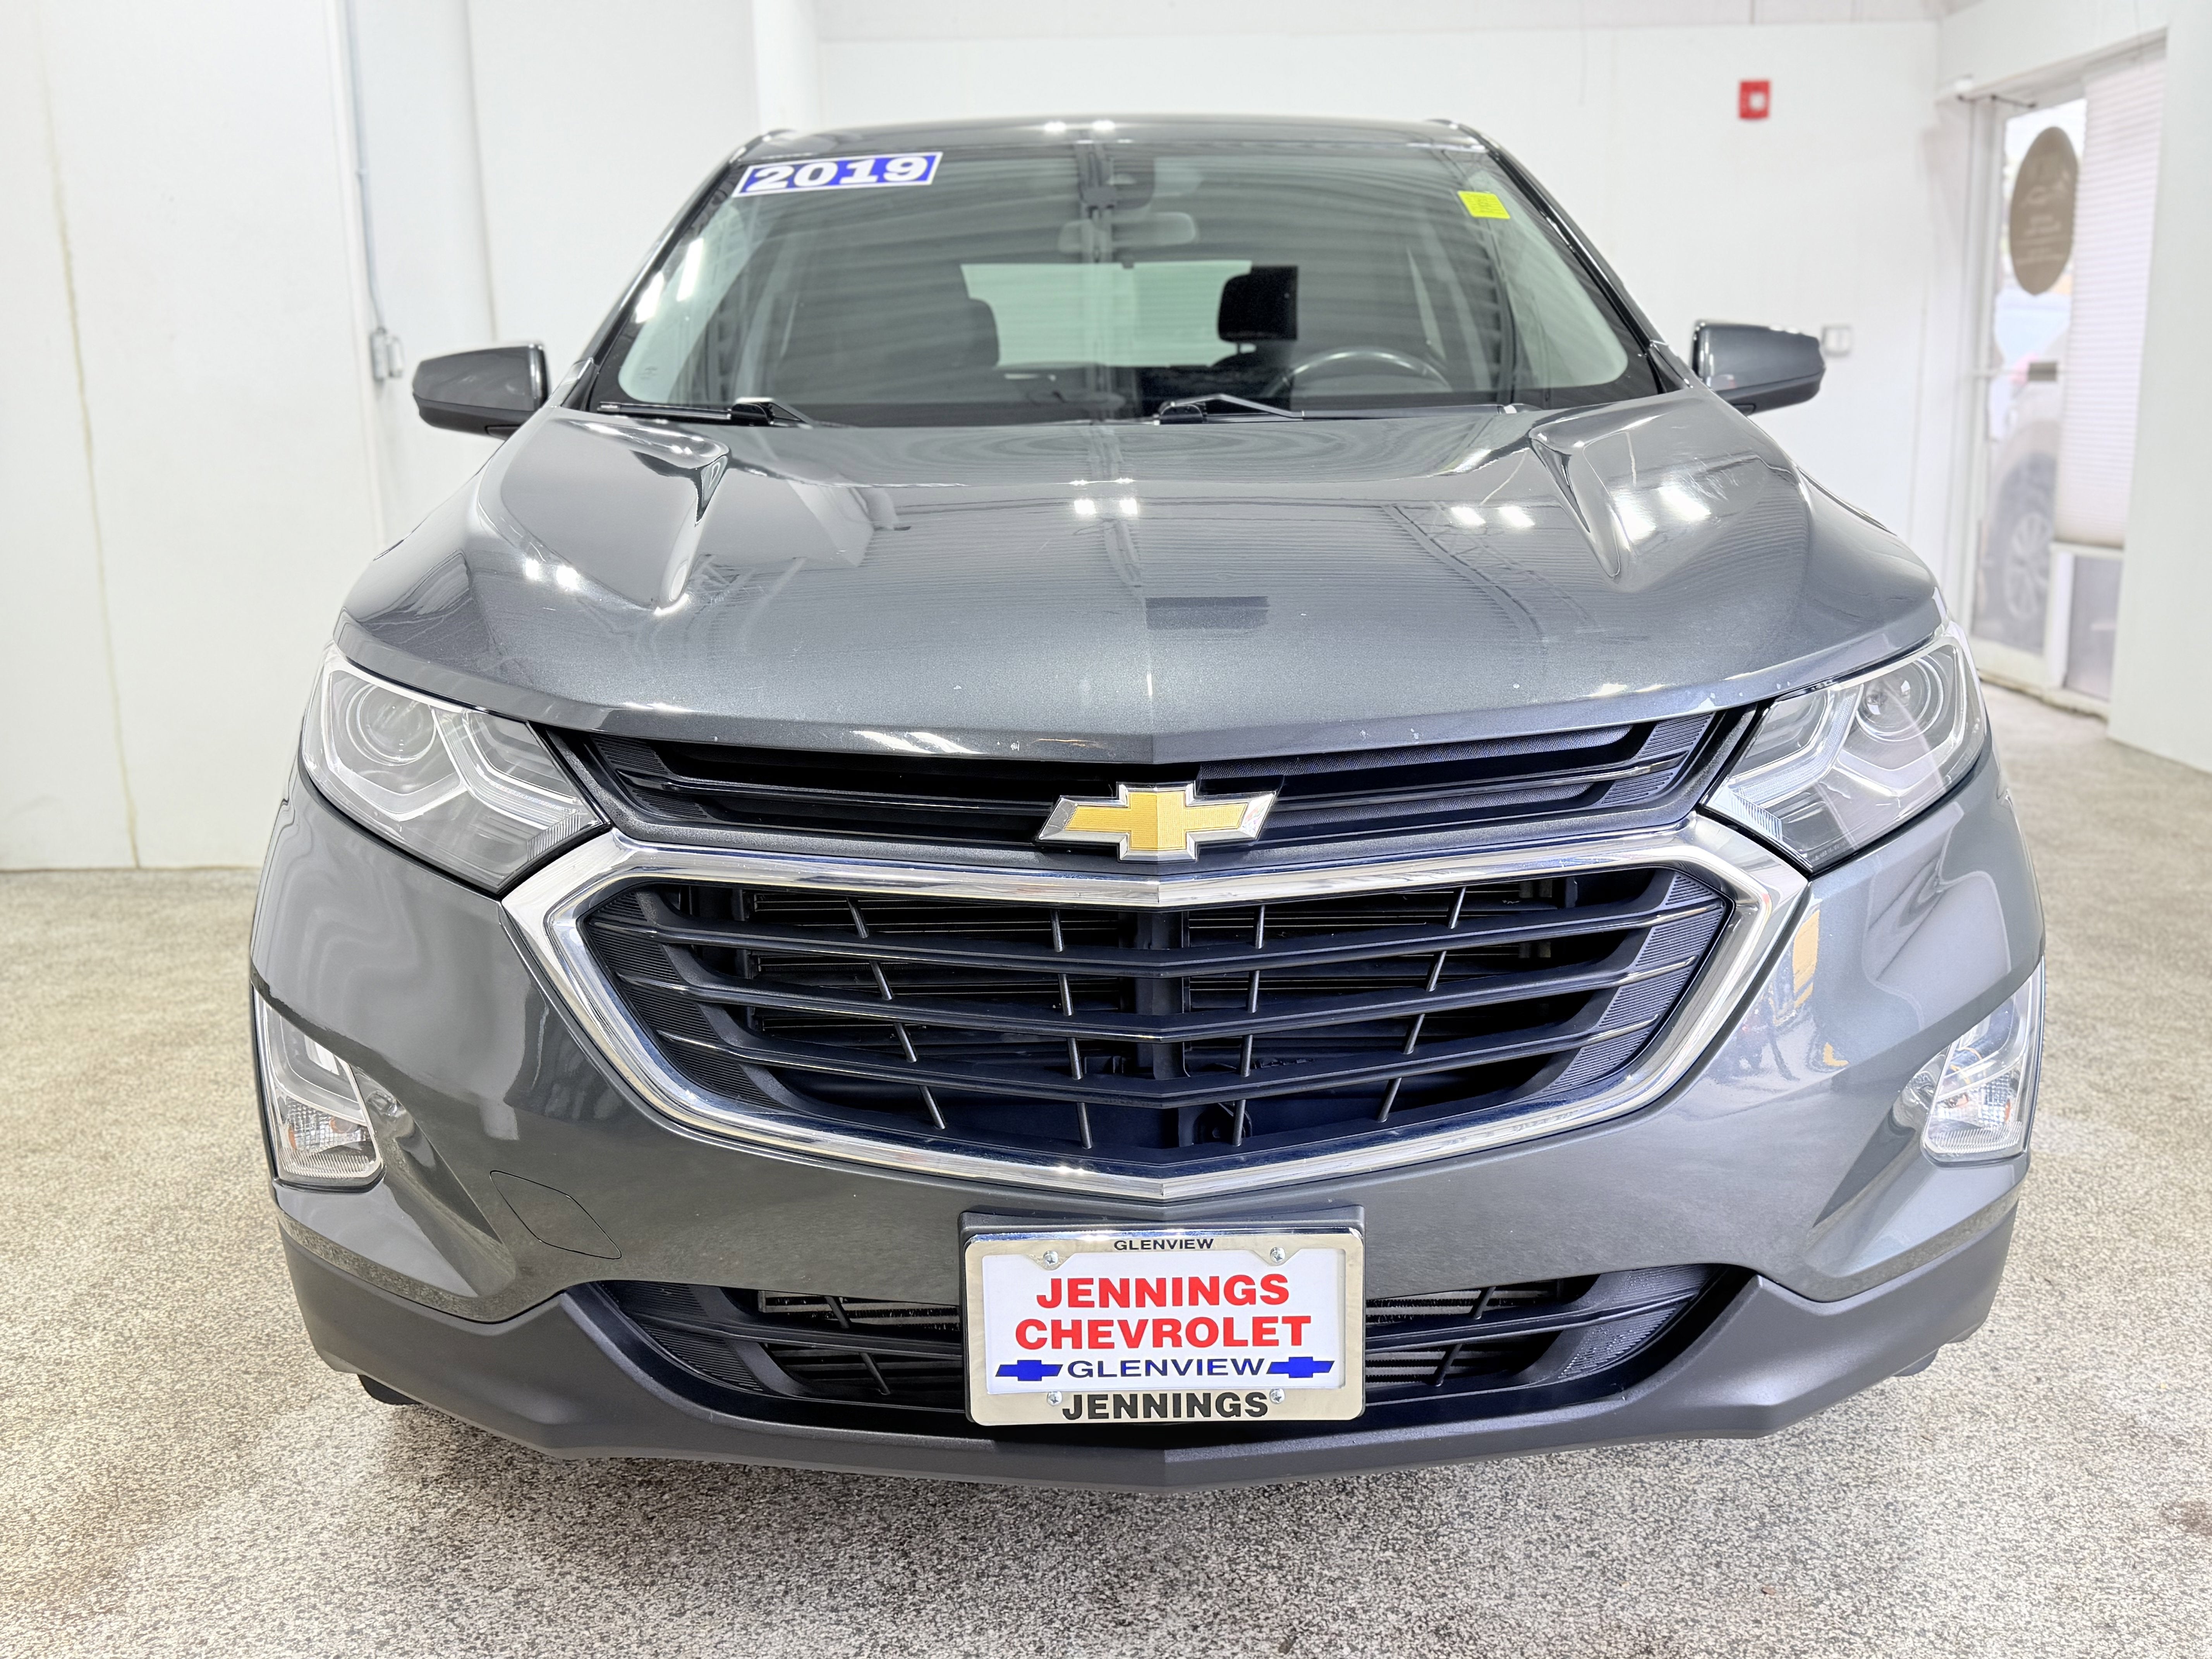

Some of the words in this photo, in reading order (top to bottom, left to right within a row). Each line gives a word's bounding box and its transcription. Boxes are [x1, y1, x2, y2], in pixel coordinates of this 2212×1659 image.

[745, 156, 928, 192] 2019
[1114, 1238, 1214, 1250] GLENVIEW
[1036, 1274, 1289, 1309] JENNINGS
[1015, 1316, 1311, 1350] CHEVROLET
[1067, 1358, 1264, 1379] GLENVIEW
[1062, 1392, 1268, 1421] JENNINGS
